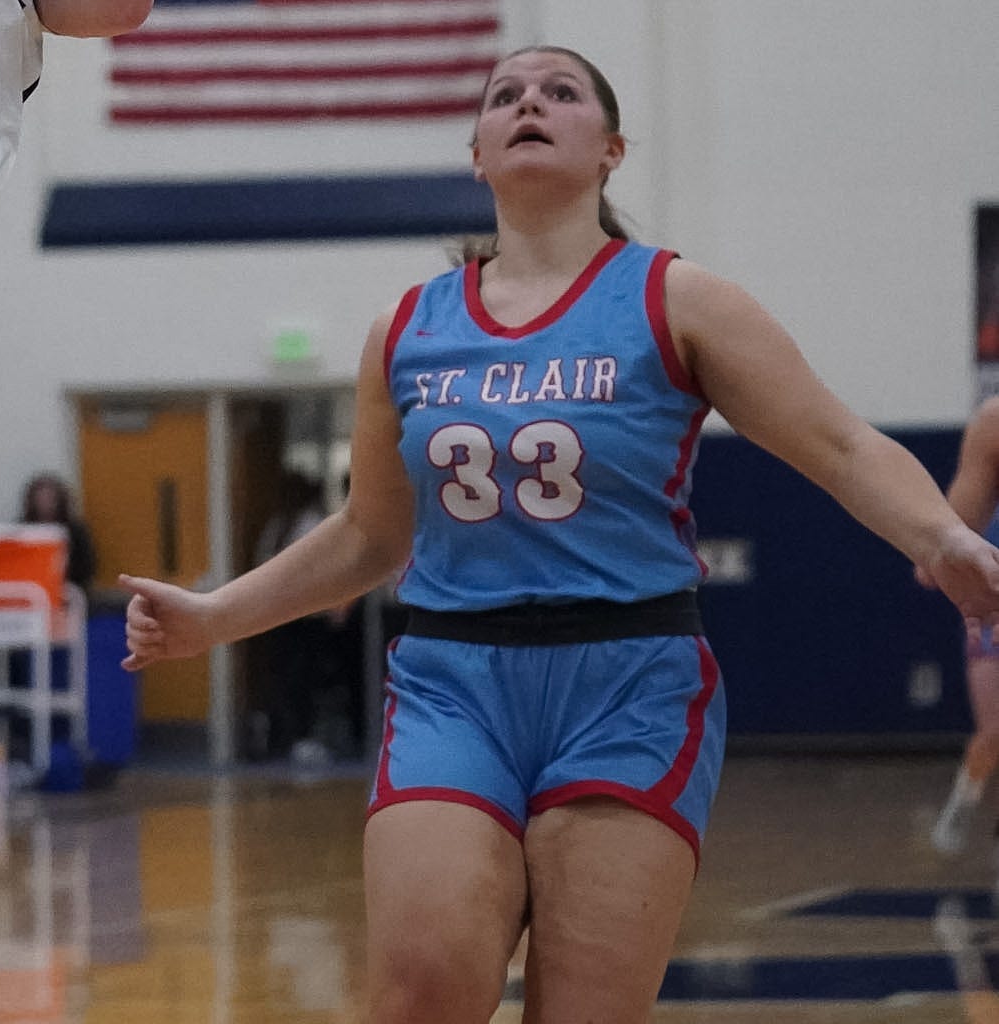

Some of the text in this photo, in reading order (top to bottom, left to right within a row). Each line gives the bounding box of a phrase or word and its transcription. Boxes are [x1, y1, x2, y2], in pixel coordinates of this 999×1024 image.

[414, 355, 617, 409] ST. CLAIR
[426, 419, 586, 523] 33
